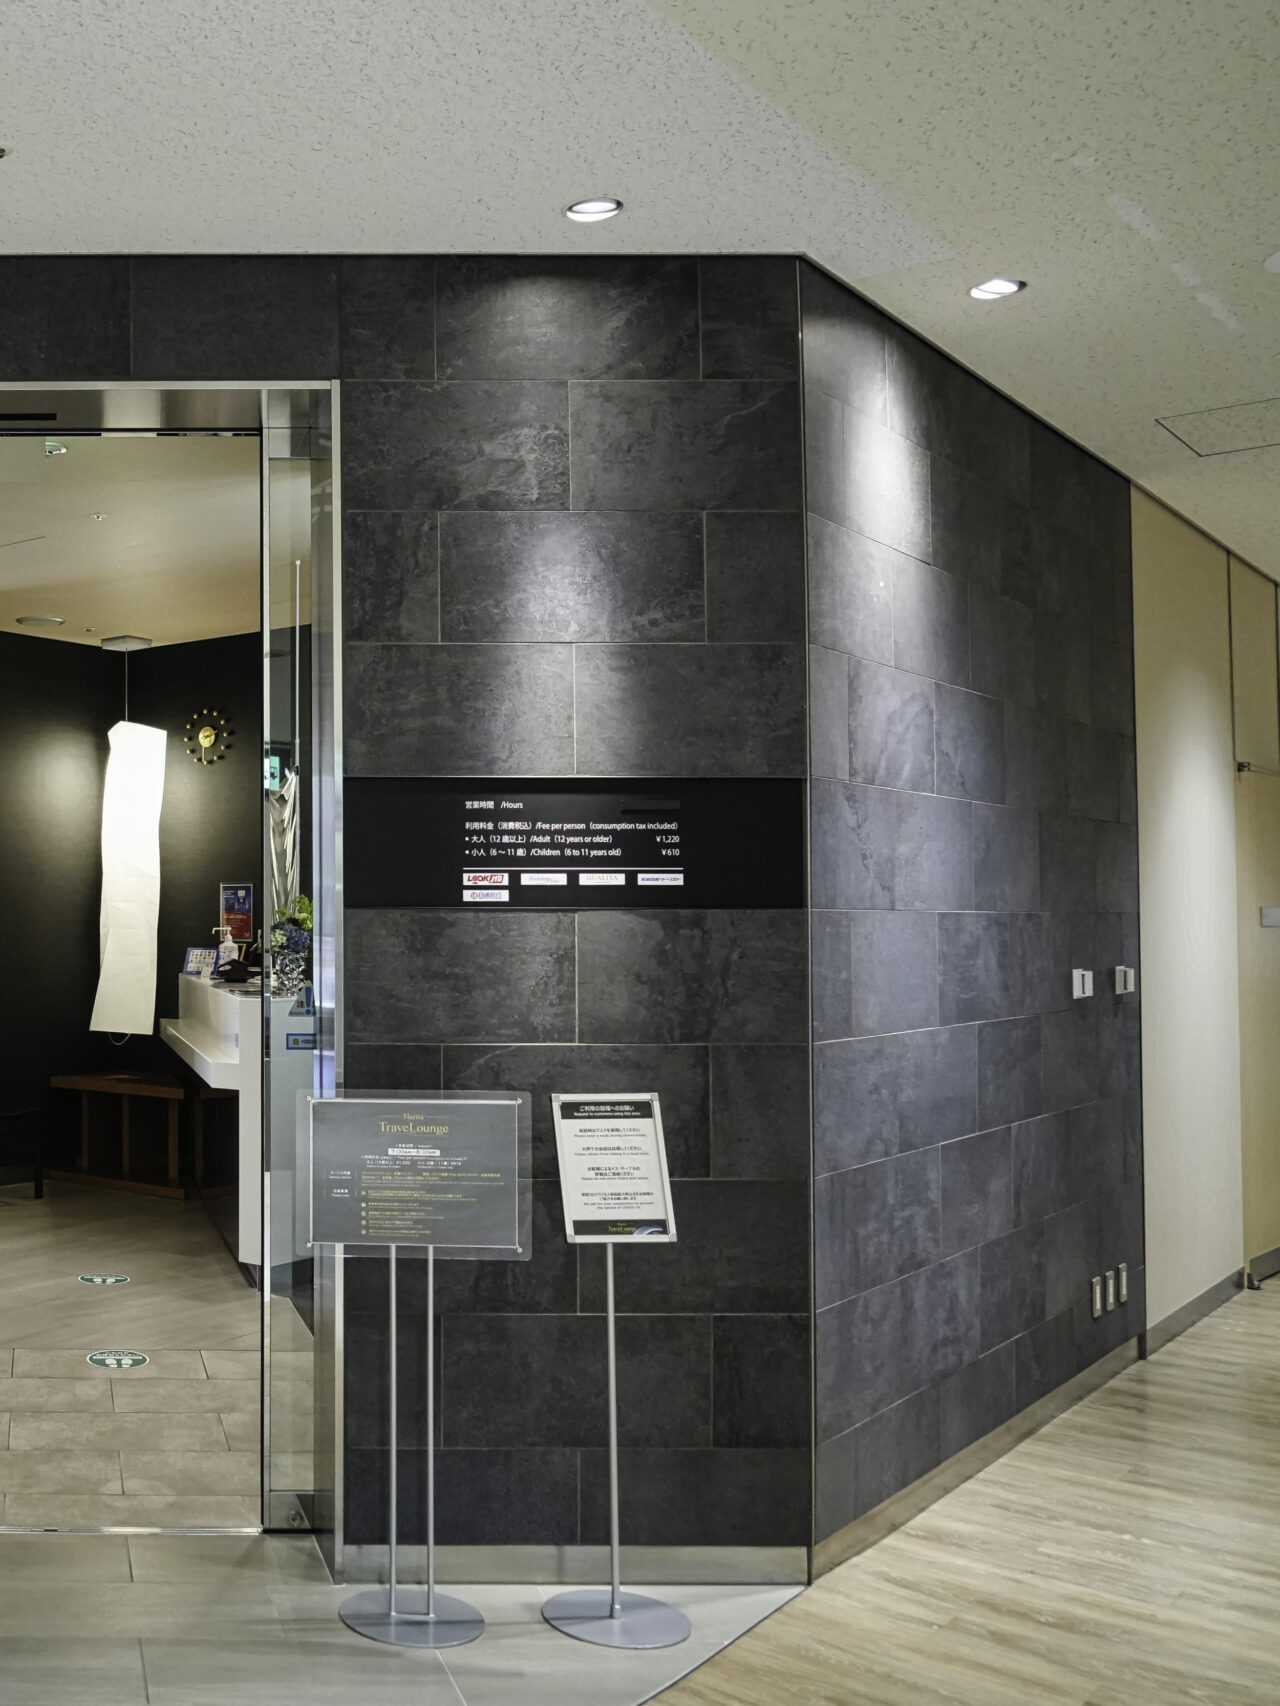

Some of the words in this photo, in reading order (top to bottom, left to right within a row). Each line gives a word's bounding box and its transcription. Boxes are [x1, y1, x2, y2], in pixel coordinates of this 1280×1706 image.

[465, 800, 494, 809] 営業時間
[551, 823, 562, 832] per
[563, 823, 586, 832] person
[636, 822, 646, 830] tax
[566, 835, 583, 844] years
[572, 849, 580, 857] to
[581, 848, 589, 856] 11
[590, 849, 607, 858] years
[379, 1121, 449, 1135] TraveLounge
